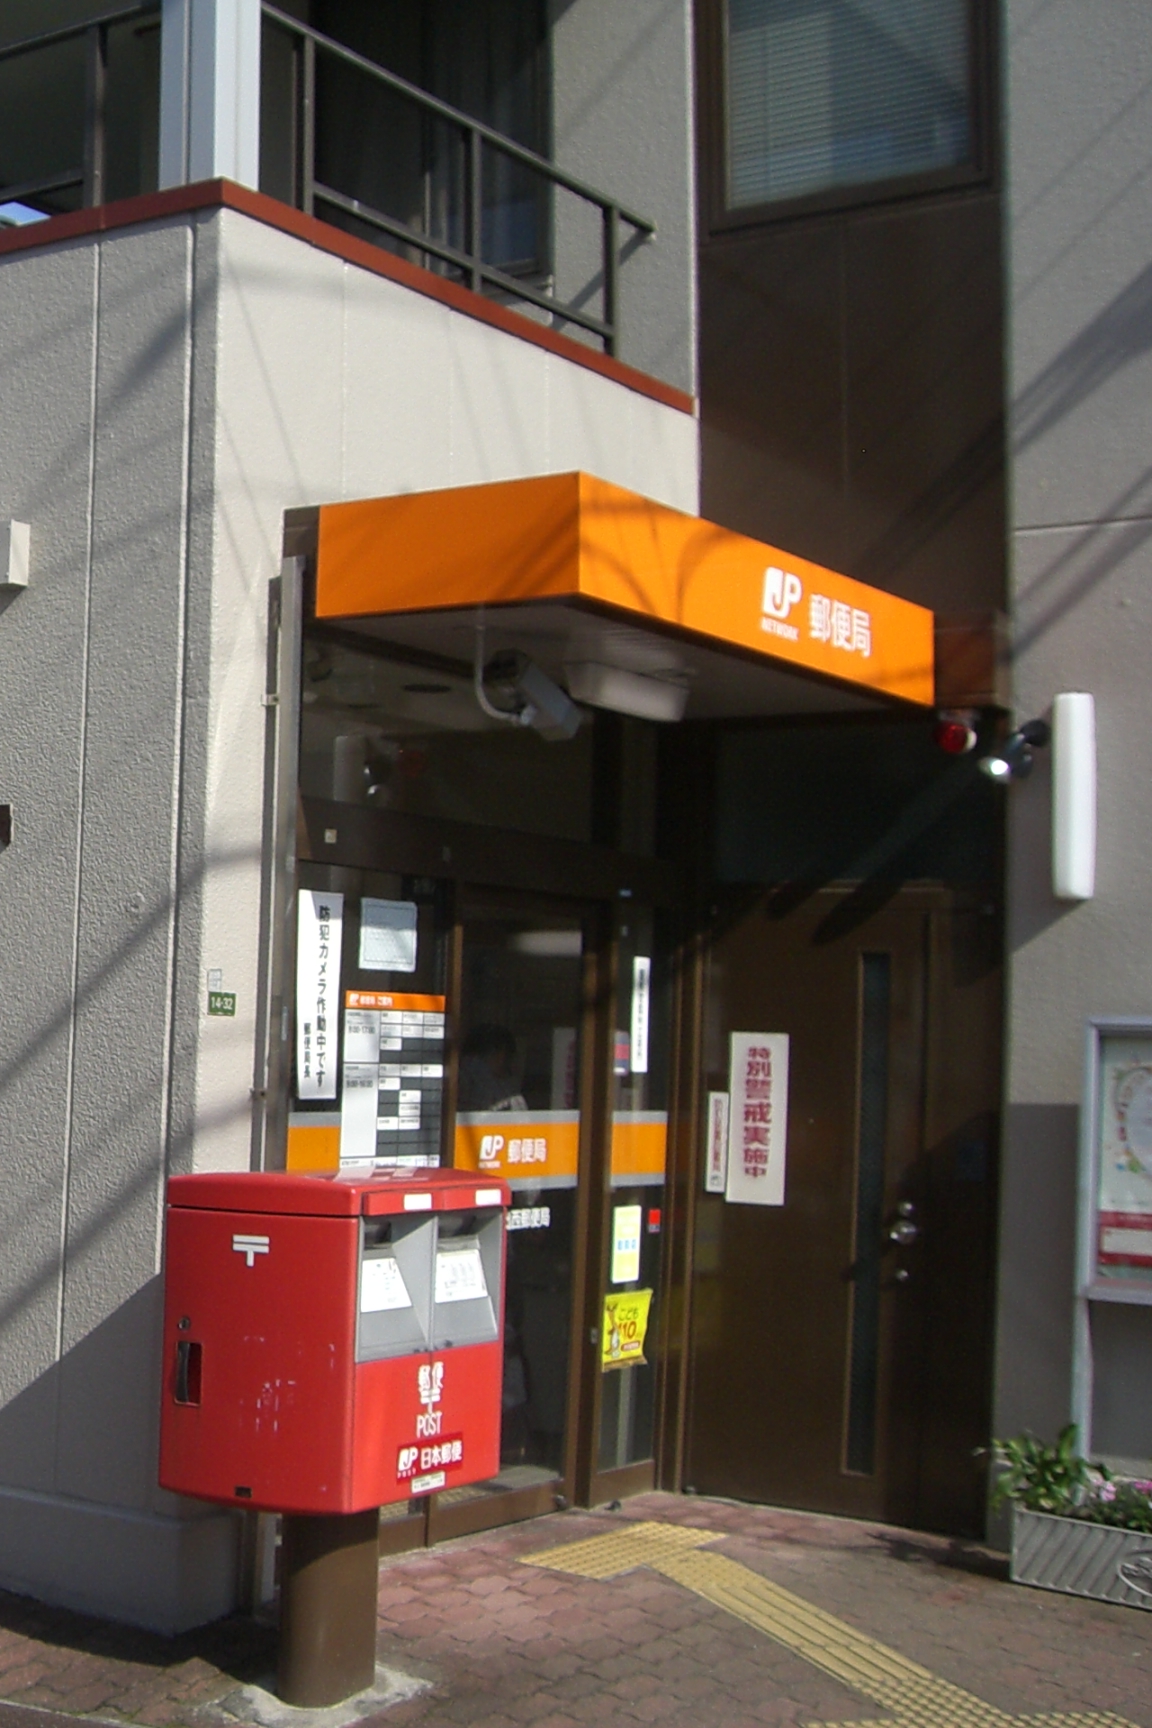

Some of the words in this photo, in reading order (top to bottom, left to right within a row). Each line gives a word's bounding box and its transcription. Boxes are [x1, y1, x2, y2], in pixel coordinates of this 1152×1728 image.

[762, 566, 802, 619] JP
[809, 593, 872, 659] 郵便局
[760, 616, 800, 642] NETWORK
[315, 904, 331, 1088] 防犯カメラ作動中です
[479, 1135, 504, 1161] JP
[507, 1138, 548, 1163] 郵便局
[505, 1206, 551, 1231] 西郵便局
[418, 1361, 444, 1391] 郵便
[416, 1411, 443, 1438] POST
[398, 1446, 419, 1472] JP
[420, 1439, 462, 1470] 日本郵便
